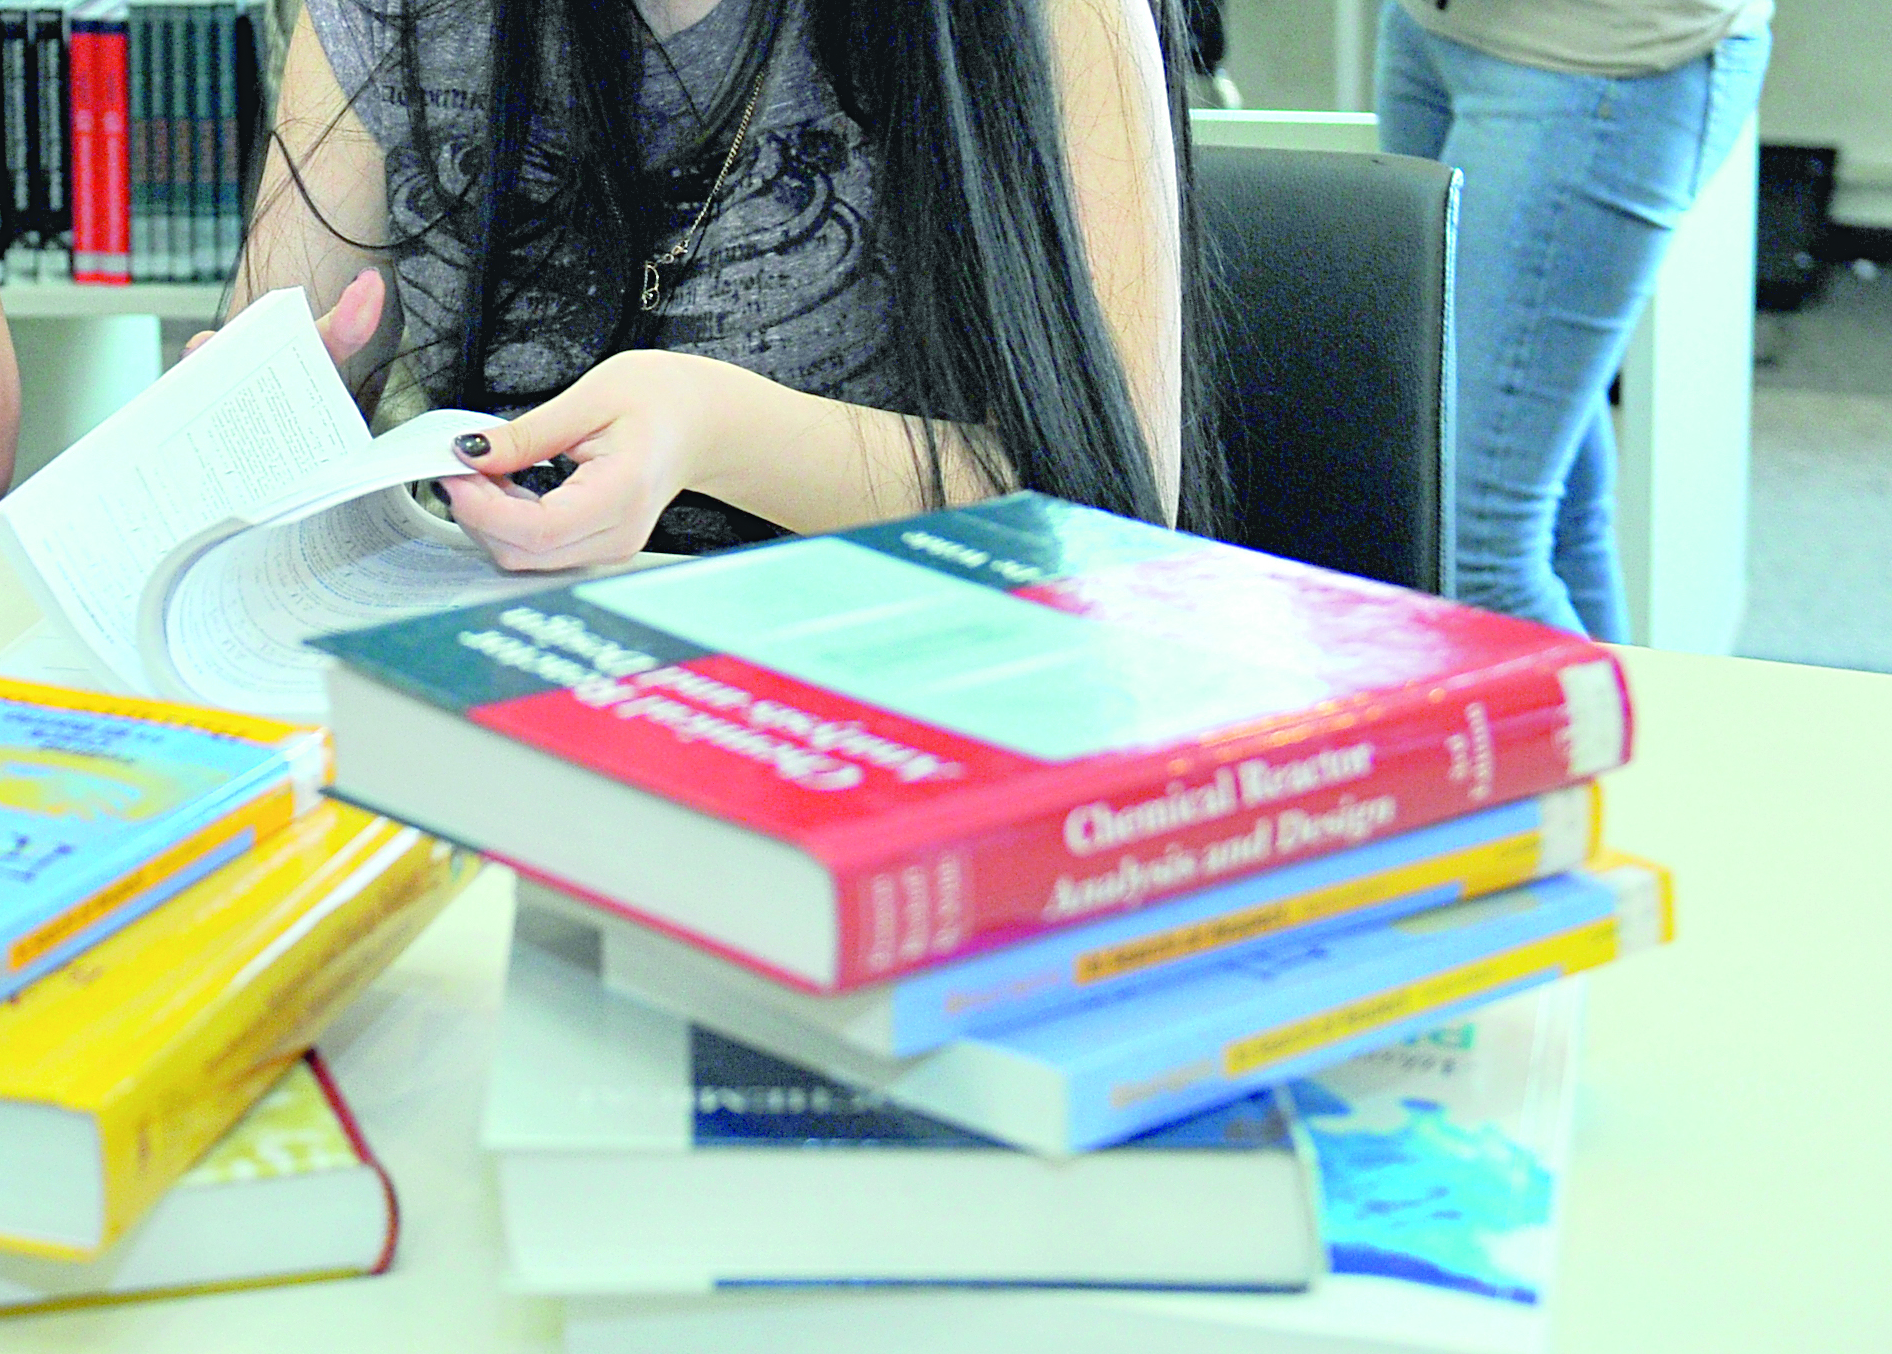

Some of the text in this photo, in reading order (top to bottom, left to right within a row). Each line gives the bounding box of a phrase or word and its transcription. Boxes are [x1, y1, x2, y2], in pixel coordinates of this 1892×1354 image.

[1044, 794, 1397, 919] Analysis and Design
[1063, 765, 1240, 855] Chemical
[1235, 742, 1375, 810] Reactor
